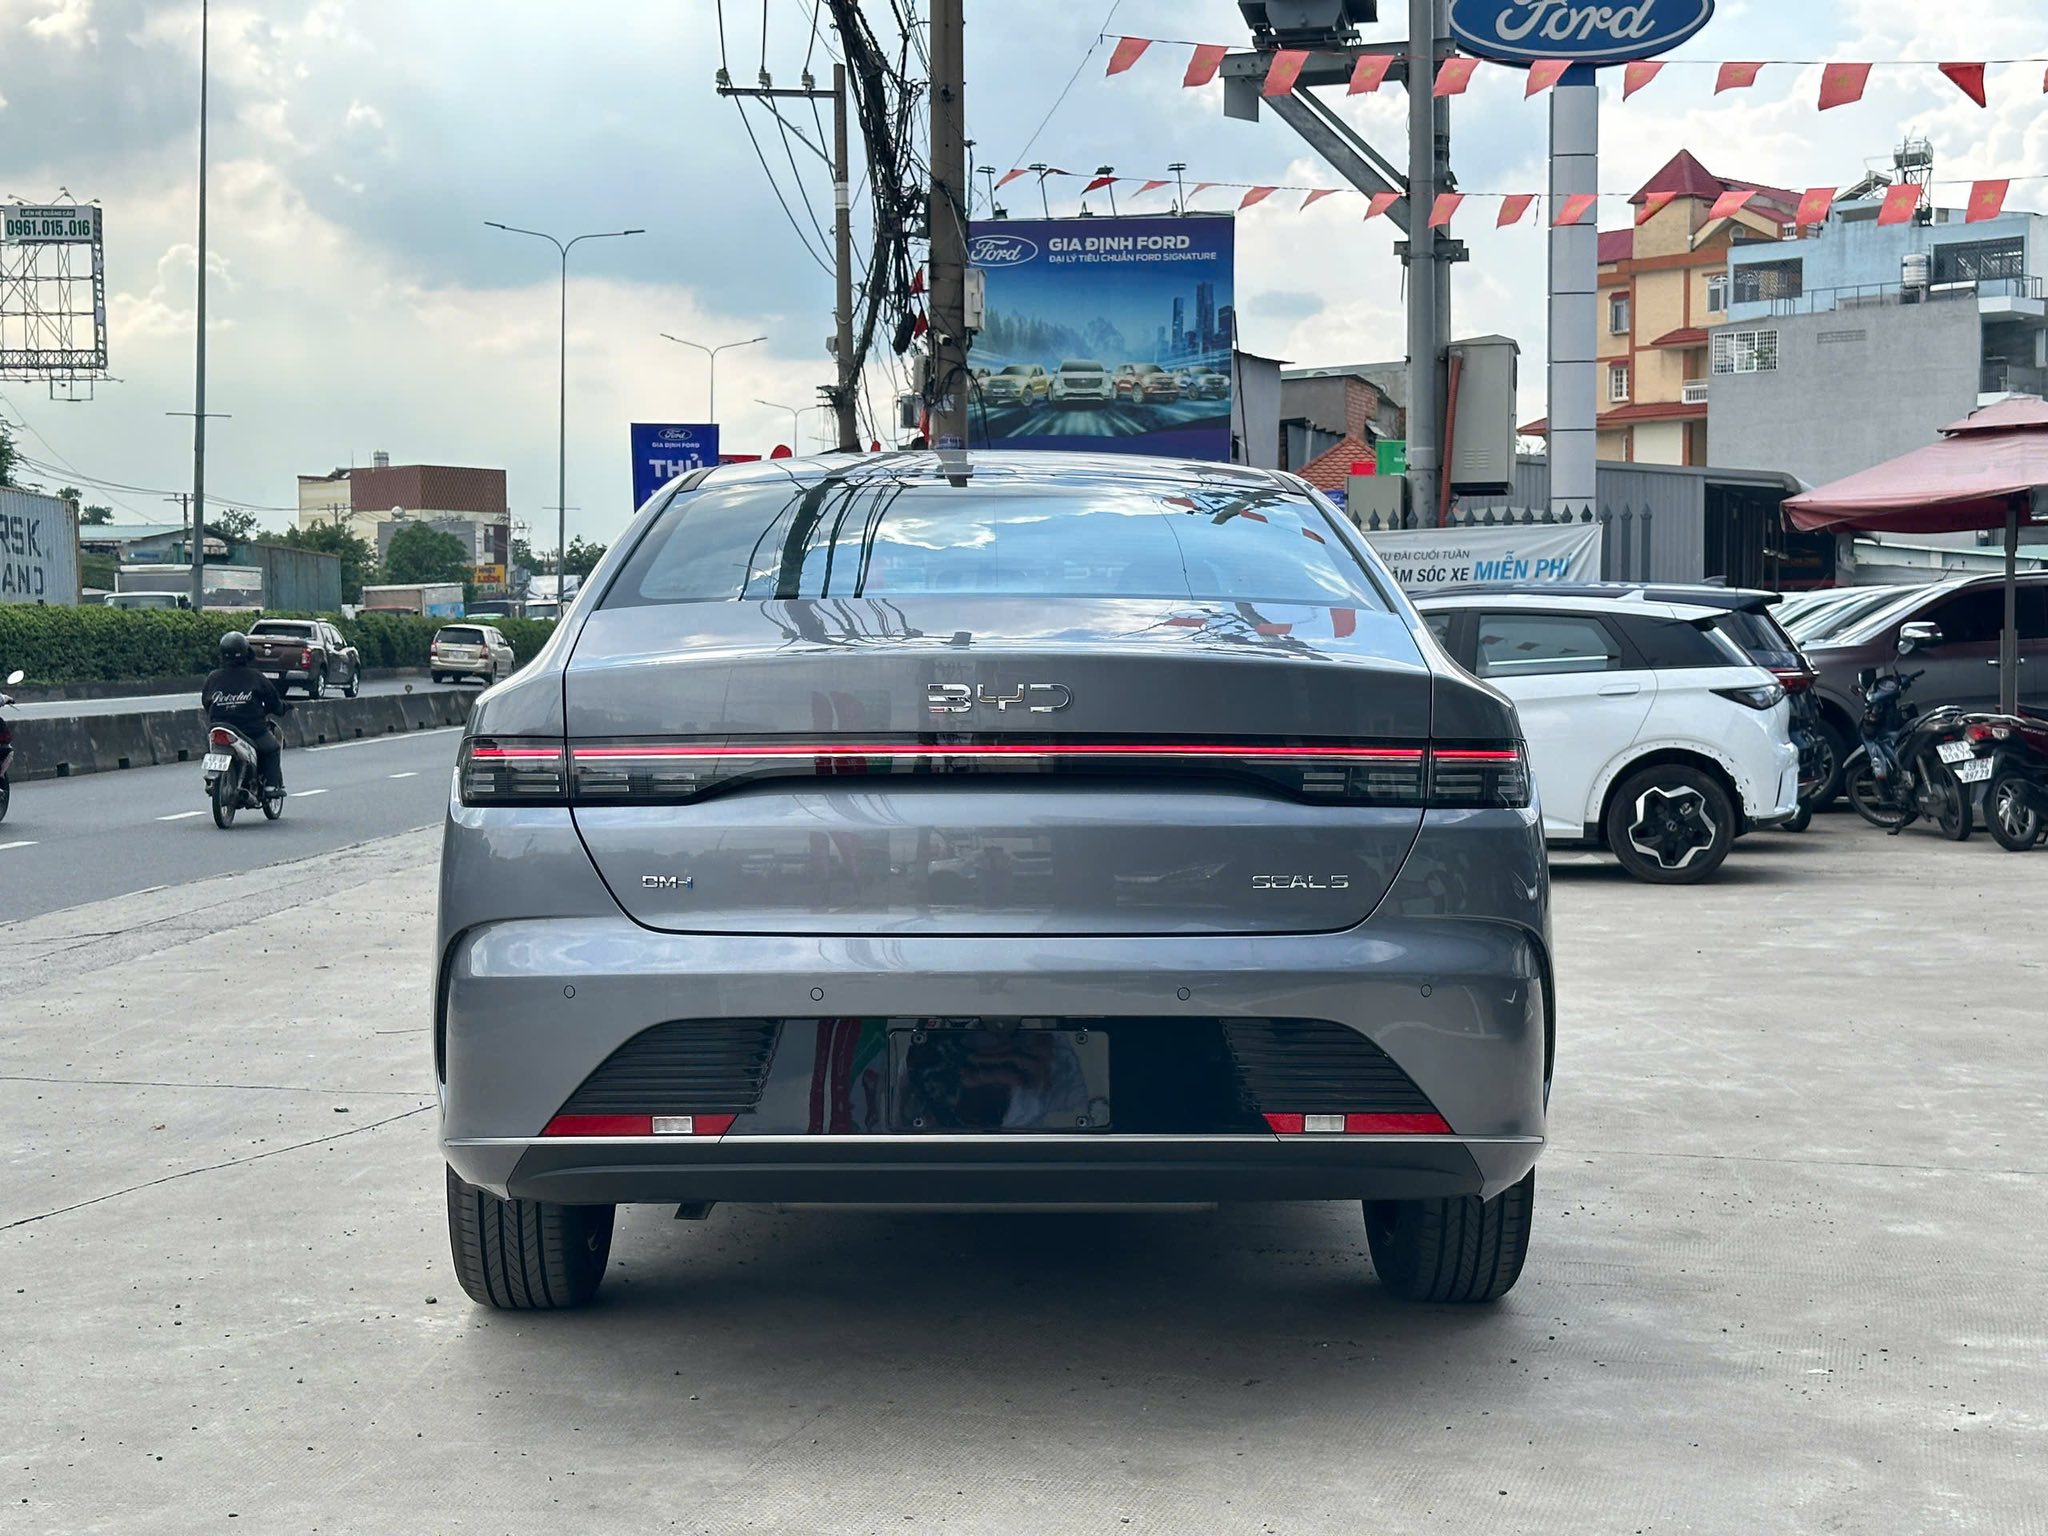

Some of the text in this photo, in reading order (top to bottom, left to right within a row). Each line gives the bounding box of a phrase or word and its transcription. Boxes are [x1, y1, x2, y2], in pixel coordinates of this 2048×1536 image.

[1495, 0, 1656, 41] Ford
[7, 219, 90, 236] 0961.015.016
[970, 239, 1023, 261] Ford
[1048, 235, 1190, 254] GIA ĐỊNH FORD
[1136, 253, 1161, 262] FORD
[1162, 251, 1217, 261] SIGNATURE
[1416, 564, 1446, 582] SÓC
[1450, 567, 1470, 582] XE
[1473, 550, 1529, 580] MIỄN
[1535, 551, 1573, 579] PHÍ
[927, 683, 1074, 713] BYD
[1252, 874, 1349, 889] SEAL 5
